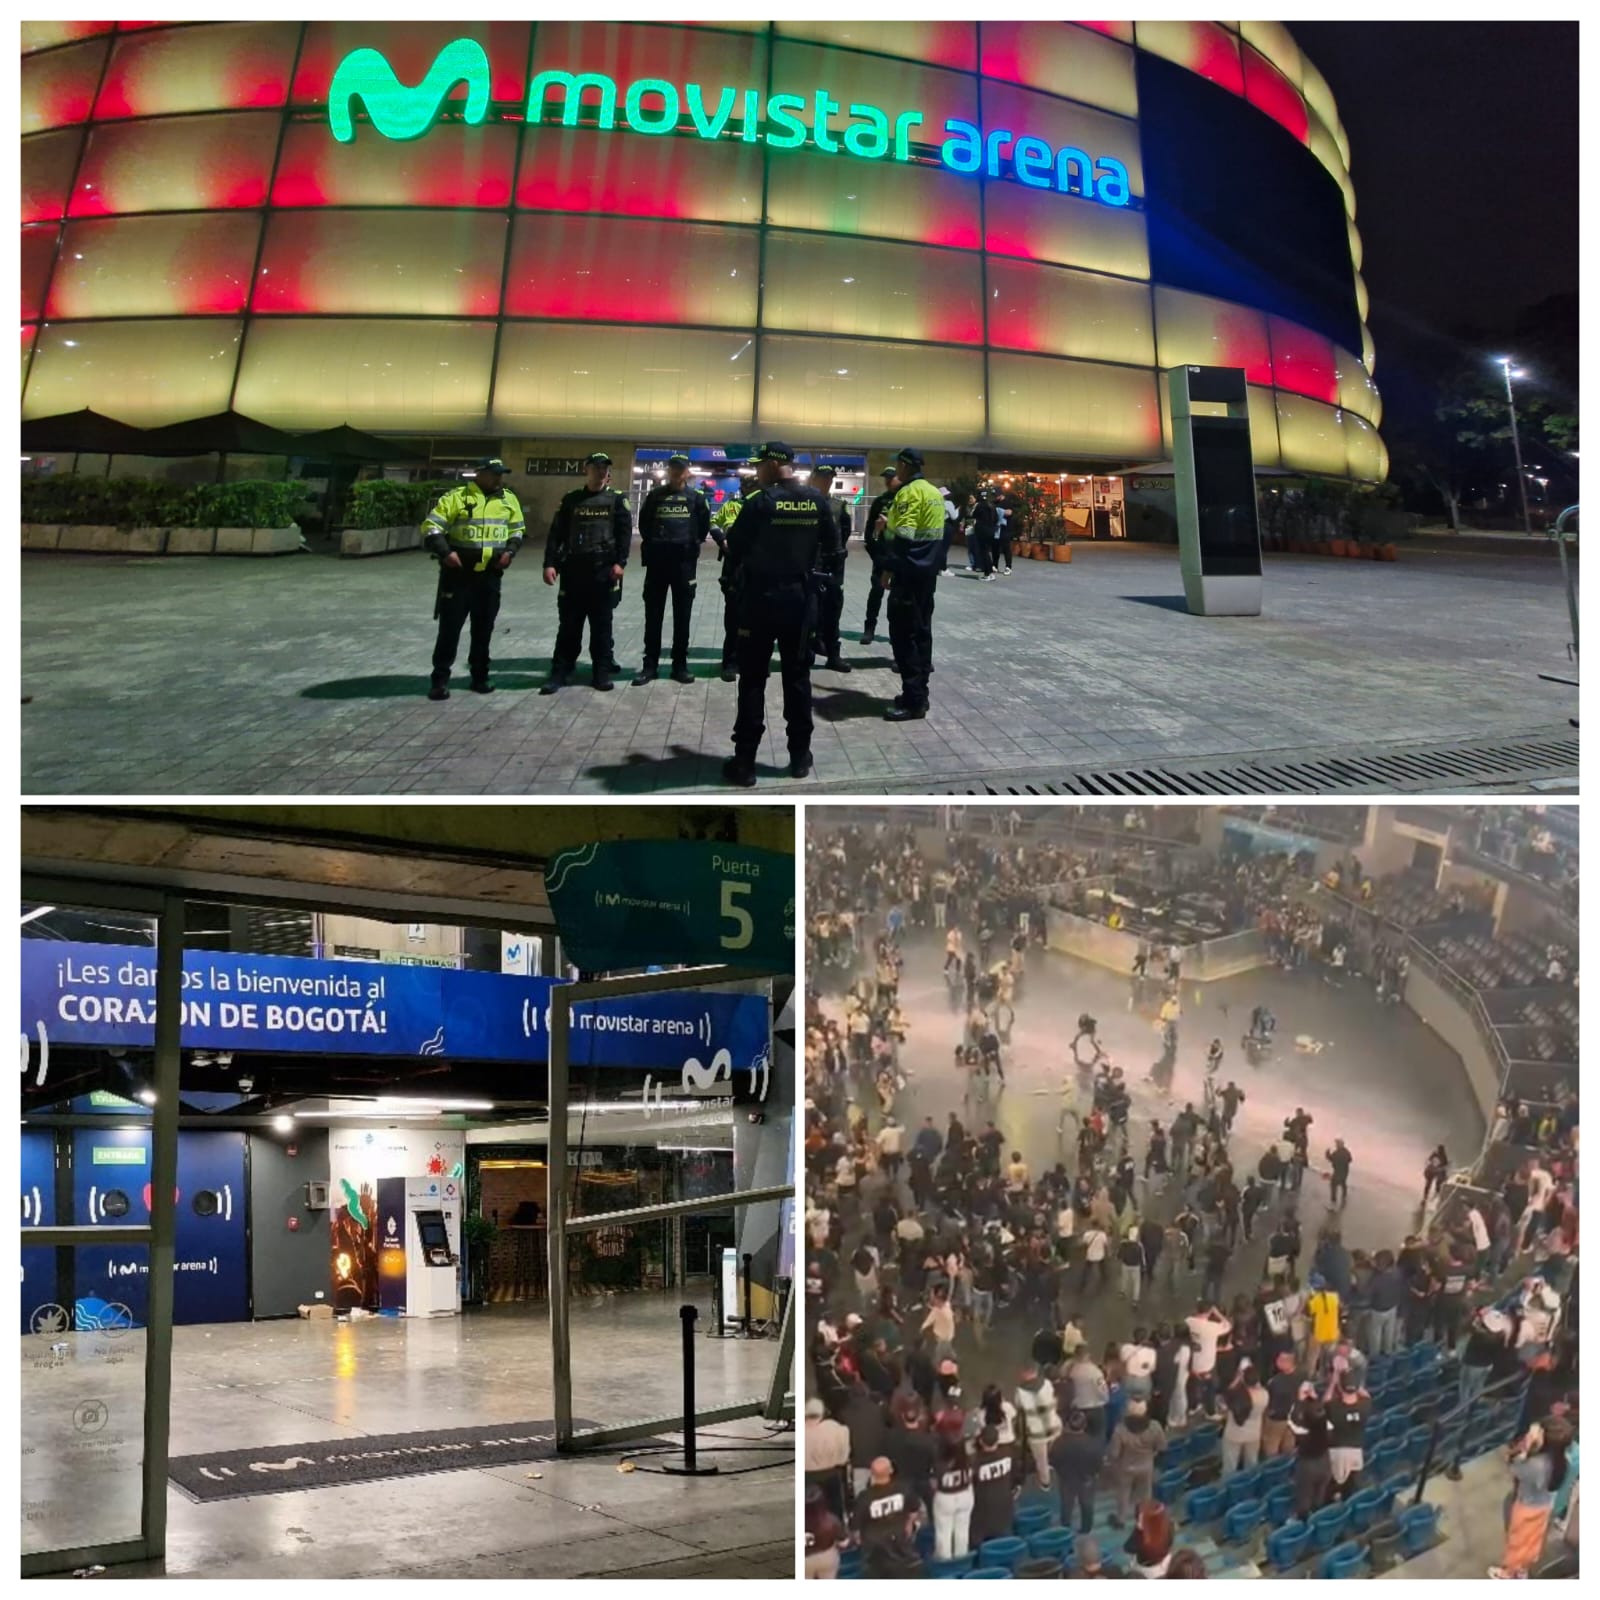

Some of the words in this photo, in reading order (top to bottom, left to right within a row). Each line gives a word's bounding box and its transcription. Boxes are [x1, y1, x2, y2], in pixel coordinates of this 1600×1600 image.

[526, 69, 924, 161] movistar
[941, 117, 1131, 207] arena
[775, 500, 817, 511] POLICÍA
[712, 855, 760, 877] Puerta
[720, 880, 754, 949] 5
[57, 957, 110, 988] ¡Les
[210, 964, 231, 991] la
[237, 967, 361, 999] bienvenida
[367, 976, 385, 999] al
[219, 1002, 258, 1030] DE
[266, 1001, 387, 1034] BOGOTÁ!
[580, 1013, 650, 1034] movistar
[652, 1018, 694, 1036] arena
[181, 1262, 207, 1271] arena
